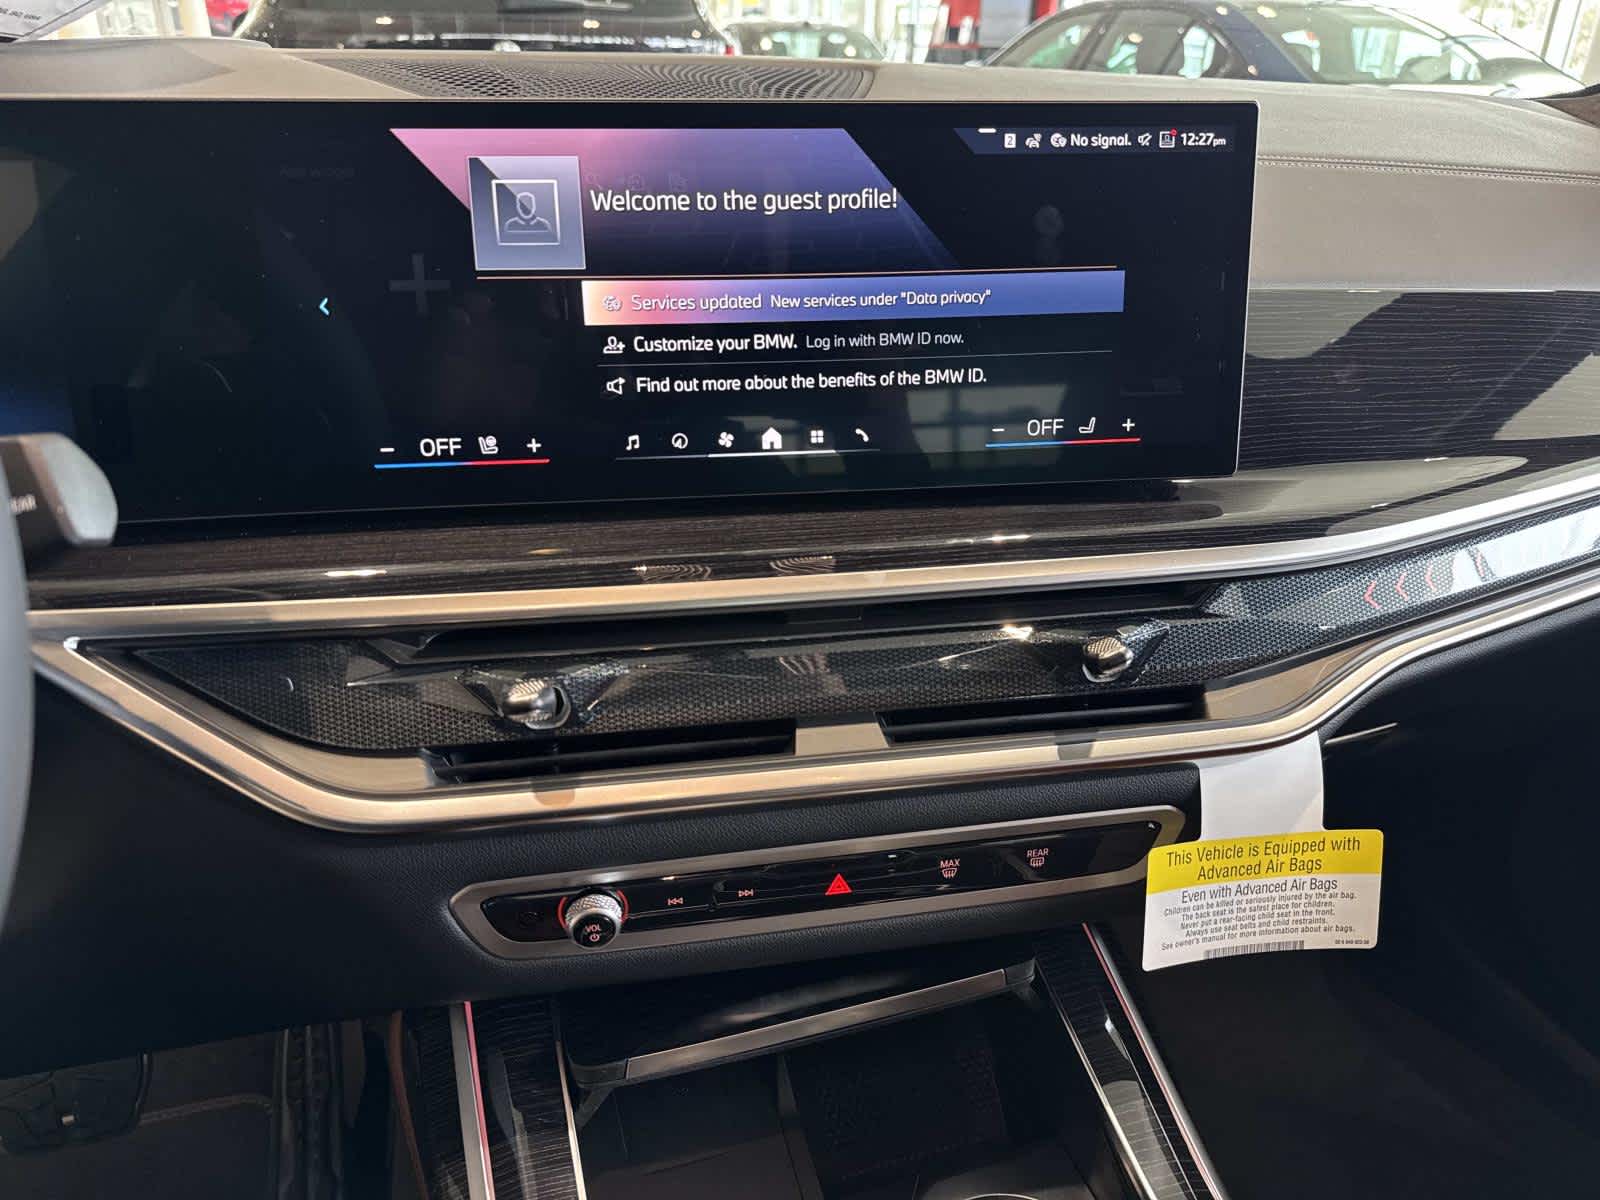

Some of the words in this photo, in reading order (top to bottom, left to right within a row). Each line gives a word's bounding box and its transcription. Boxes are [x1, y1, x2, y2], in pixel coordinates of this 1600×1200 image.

[1071, 133, 1088, 147] No
[1091, 133, 1132, 149] signal.
[1180, 133, 1226, 147] 12:27pm
[590, 190, 690, 212] Welcome
[697, 191, 717, 211] to
[723, 189, 757, 211] the
[763, 191, 822, 215] guest
[828, 188, 898, 214] profile!
[631, 295, 695, 310] Services
[700, 293, 762, 312] updated
[770, 295, 800, 308] New
[803, 294, 856, 308] services
[860, 292, 898, 306] under
[901, 291, 937, 305] "Data
[940, 289, 991, 306] privacy"
[633, 336, 713, 352] Customize
[716, 338, 750, 353] your
[754, 334, 798, 349] BMW.
[806, 335, 830, 350] Log
[834, 335, 845, 347] in
[849, 334, 875, 347] with
[879, 332, 914, 346] BMW
[917, 332, 931, 345] ID
[934, 333, 964, 344] now.
[636, 377, 670, 392] Find
[674, 378, 699, 392] out
[702, 378, 741, 391] more
[745, 375, 788, 389] about
[791, 374, 815, 389] the
[819, 372, 876, 388] benefits
[879, 371, 895, 386] of
[897, 371, 921, 385] the
[925, 369, 964, 385] BMW
[968, 368, 987, 383] ID.
[1027, 418, 1064, 436] OFF
[420, 438, 462, 457] OFF
[1026, 848, 1049, 858] REAR
[1167, 850, 1192, 867] This
[1197, 844, 1244, 862] Vehicle
[1248, 843, 1259, 857] is
[1264, 837, 1326, 857] Equipped
[1331, 837, 1360, 851] with
[940, 859, 960, 868] MAX
[1197, 860, 1261, 880] Advanced
[1266, 859, 1285, 873] Air
[1290, 857, 1322, 873] Bags
[1182, 890, 1206, 903] Even
[1209, 885, 1232, 899] with
[1235, 880, 1287, 897] Advanced
[1290, 878, 1307, 891] Air
[1310, 877, 1338, 892] Bags
[1164, 906, 1190, 917] Children
[1192, 903, 1204, 911] can
[1206, 901, 1214, 909] be
[1216, 900, 1233, 908] killed
[1245, 895, 1276, 903] seriously
[1278, 892, 1302, 902] injured
[585, 924, 601, 932] VOL
[1180, 921, 1198, 930] Never
[1201, 920, 1212, 928] put
[1220, 915, 1255, 923] rear-facing
[1258, 912, 1274, 920] child
[1186, 928, 1208, 937] Always
[1224, 924, 1238, 932] seat
[1258, 920, 1271, 928] and
[1292, 917, 1328, 925] restraints.
